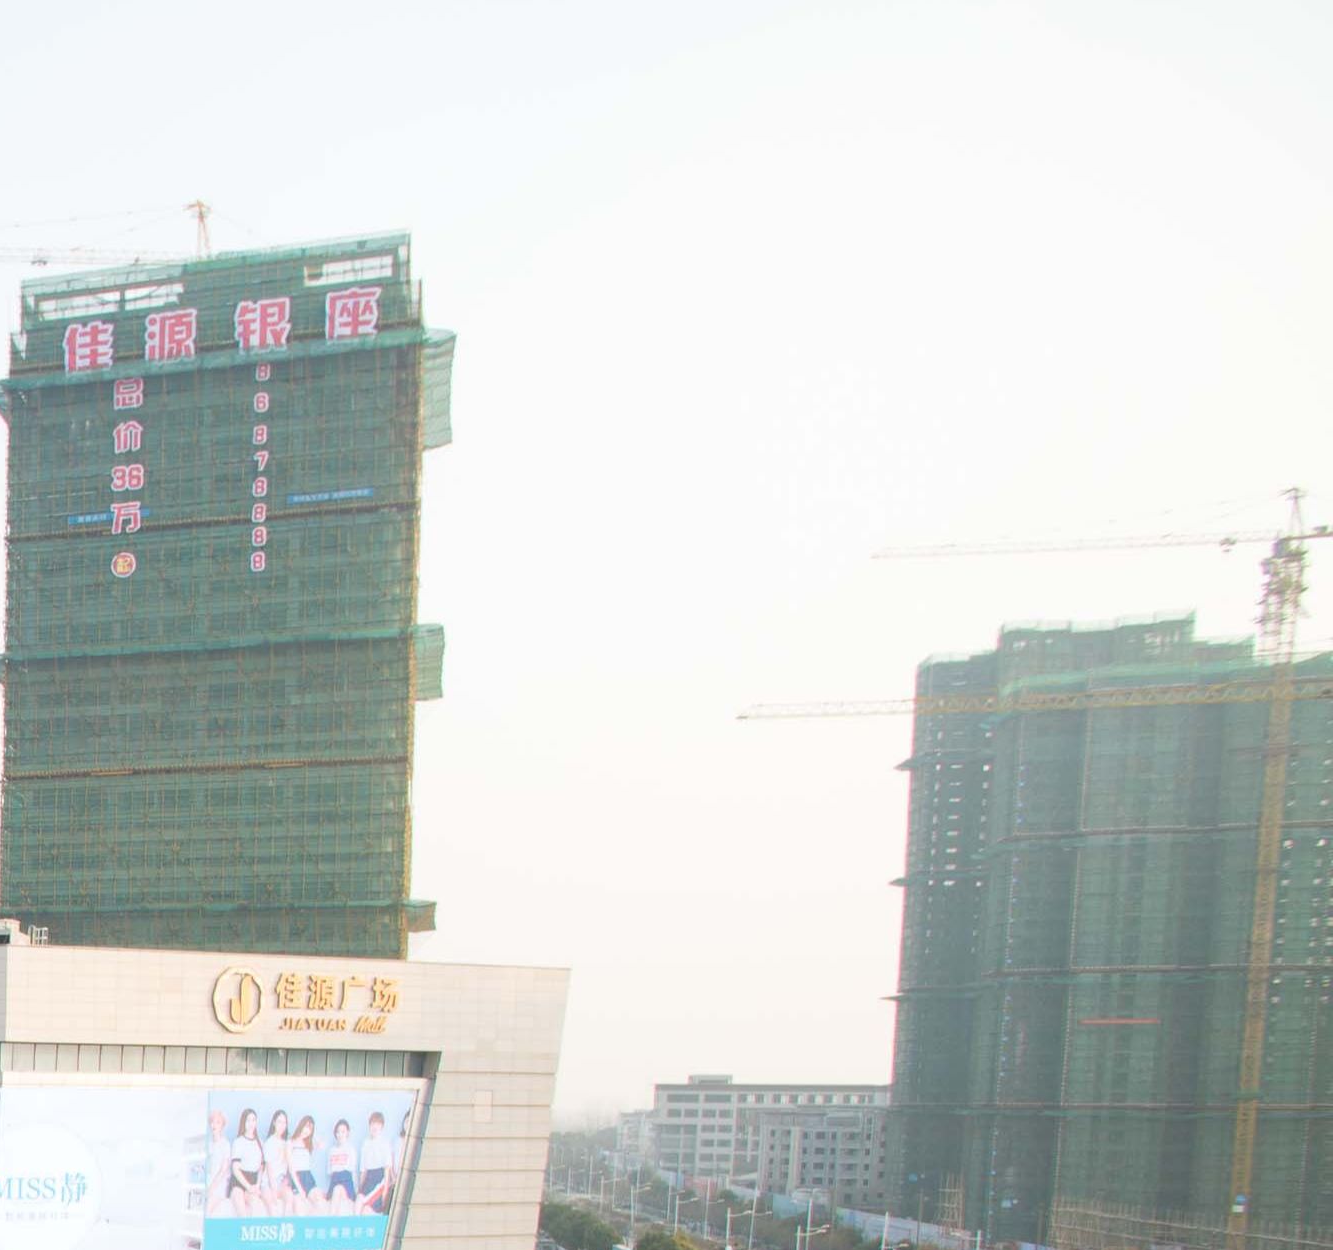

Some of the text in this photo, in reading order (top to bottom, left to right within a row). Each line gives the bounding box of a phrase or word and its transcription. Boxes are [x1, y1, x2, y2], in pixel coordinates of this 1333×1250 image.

[63, 286, 382, 373] 佳源银座
[250, 363, 271, 572] 86878888
[275, 972, 400, 1012] 佳源广场
[279, 1017, 347, 1031] JIAYUAN
